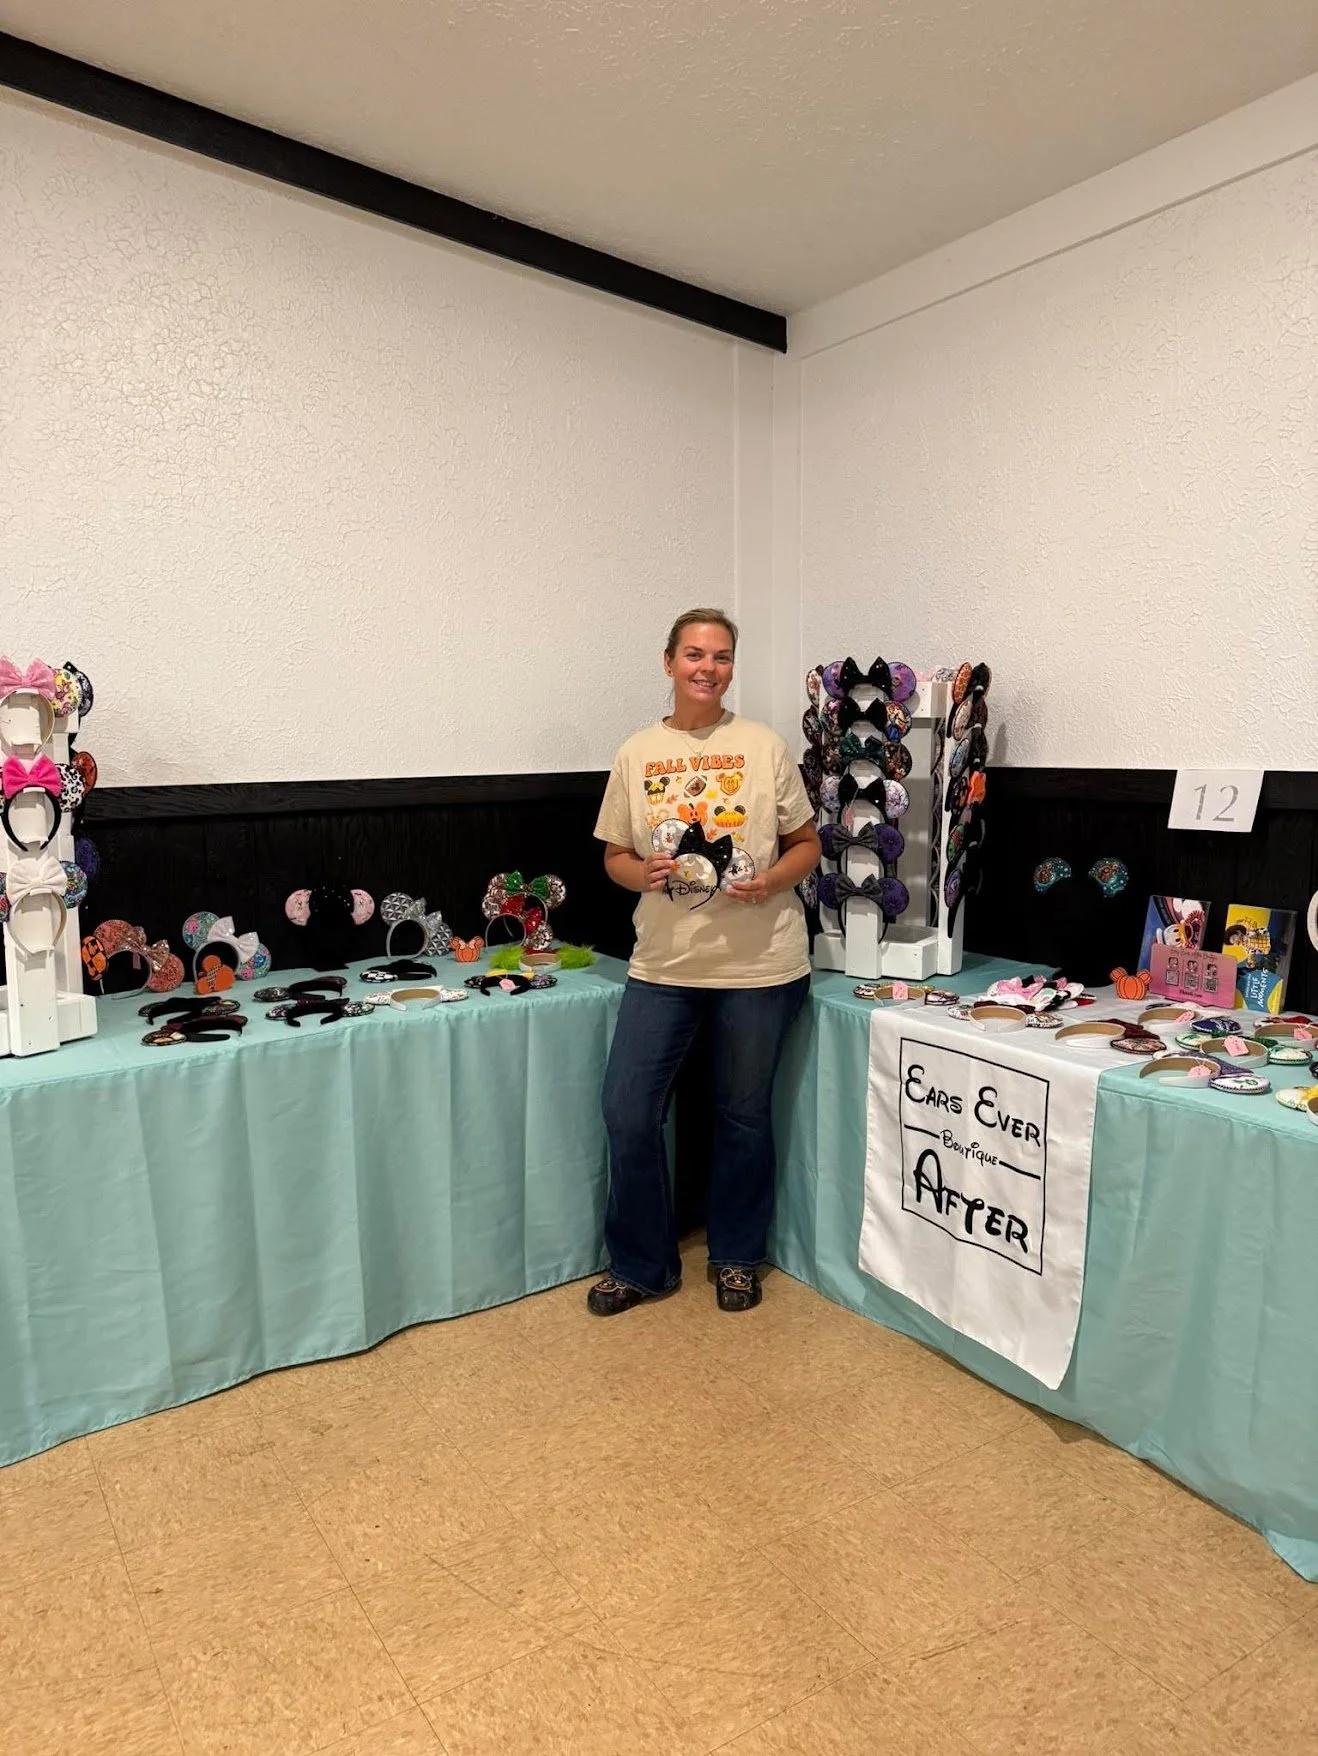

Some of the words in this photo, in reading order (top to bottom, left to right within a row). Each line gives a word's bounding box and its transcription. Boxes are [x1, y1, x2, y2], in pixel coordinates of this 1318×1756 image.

[645, 758, 687, 777] FALL
[689, 754, 745, 771] VIBES
[1194, 783, 1239, 822] 12
[1251, 977, 1260, 998] LITTLE
[1257, 967, 1268, 1007] MOMENTS
[905, 1064, 963, 1115] EARS
[974, 1086, 1041, 1147] EVER
[940, 1129, 998, 1167] Boutique
[913, 1149, 1029, 1253] AFTER
